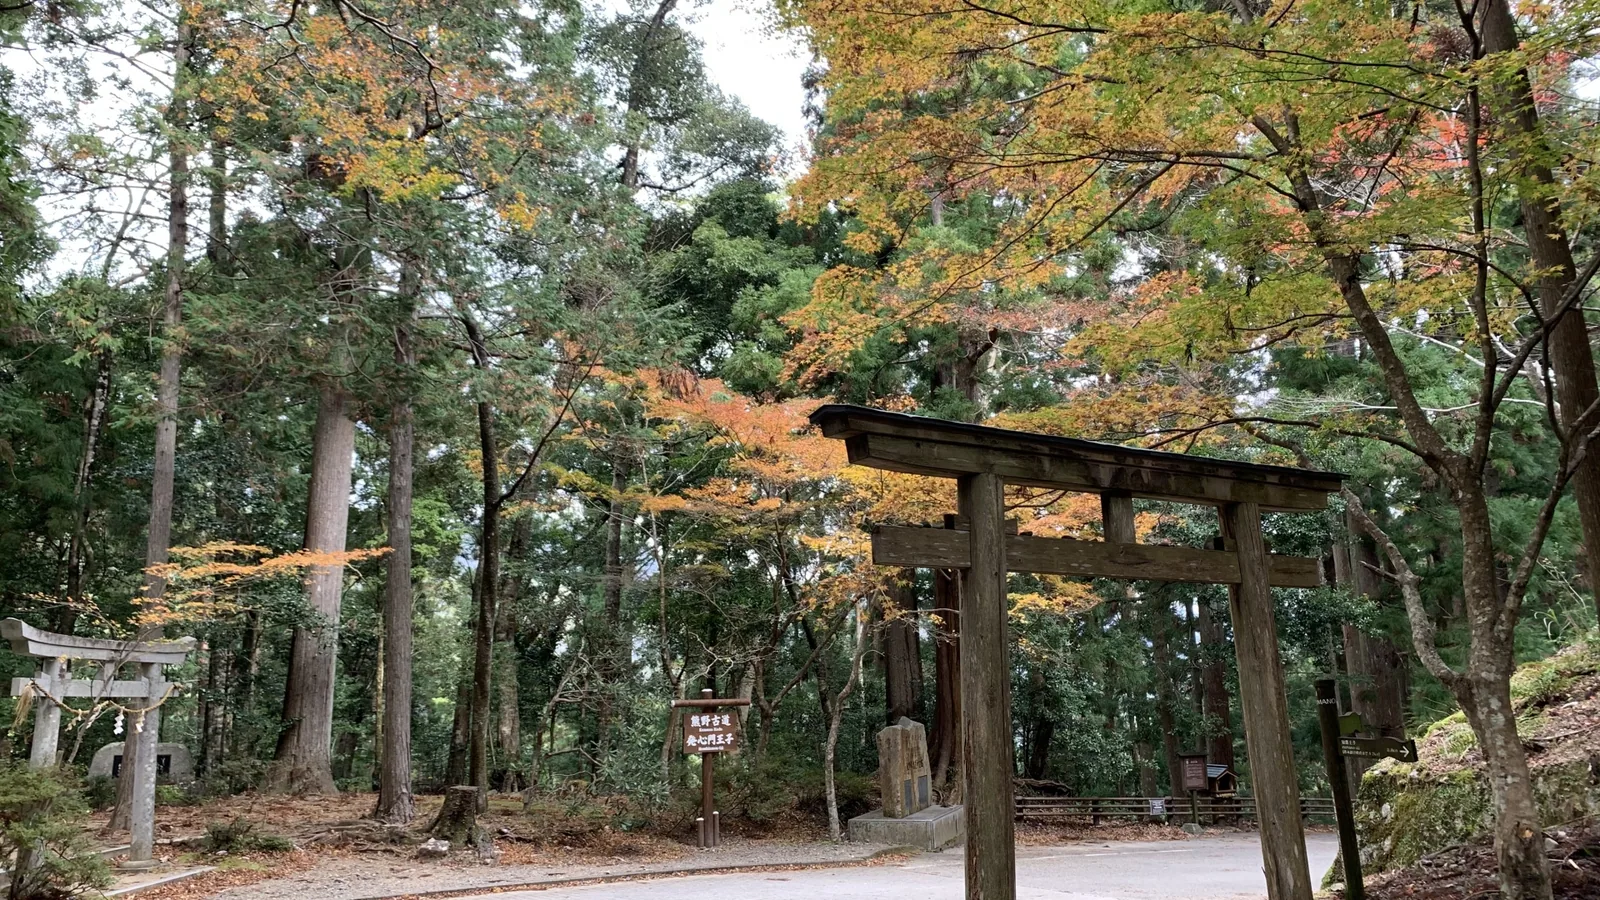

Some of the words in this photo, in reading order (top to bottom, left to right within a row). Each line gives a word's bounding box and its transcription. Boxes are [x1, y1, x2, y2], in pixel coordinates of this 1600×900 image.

[691, 714, 731, 727] 熊野古道
[687, 733, 734, 746] 発心門王子
